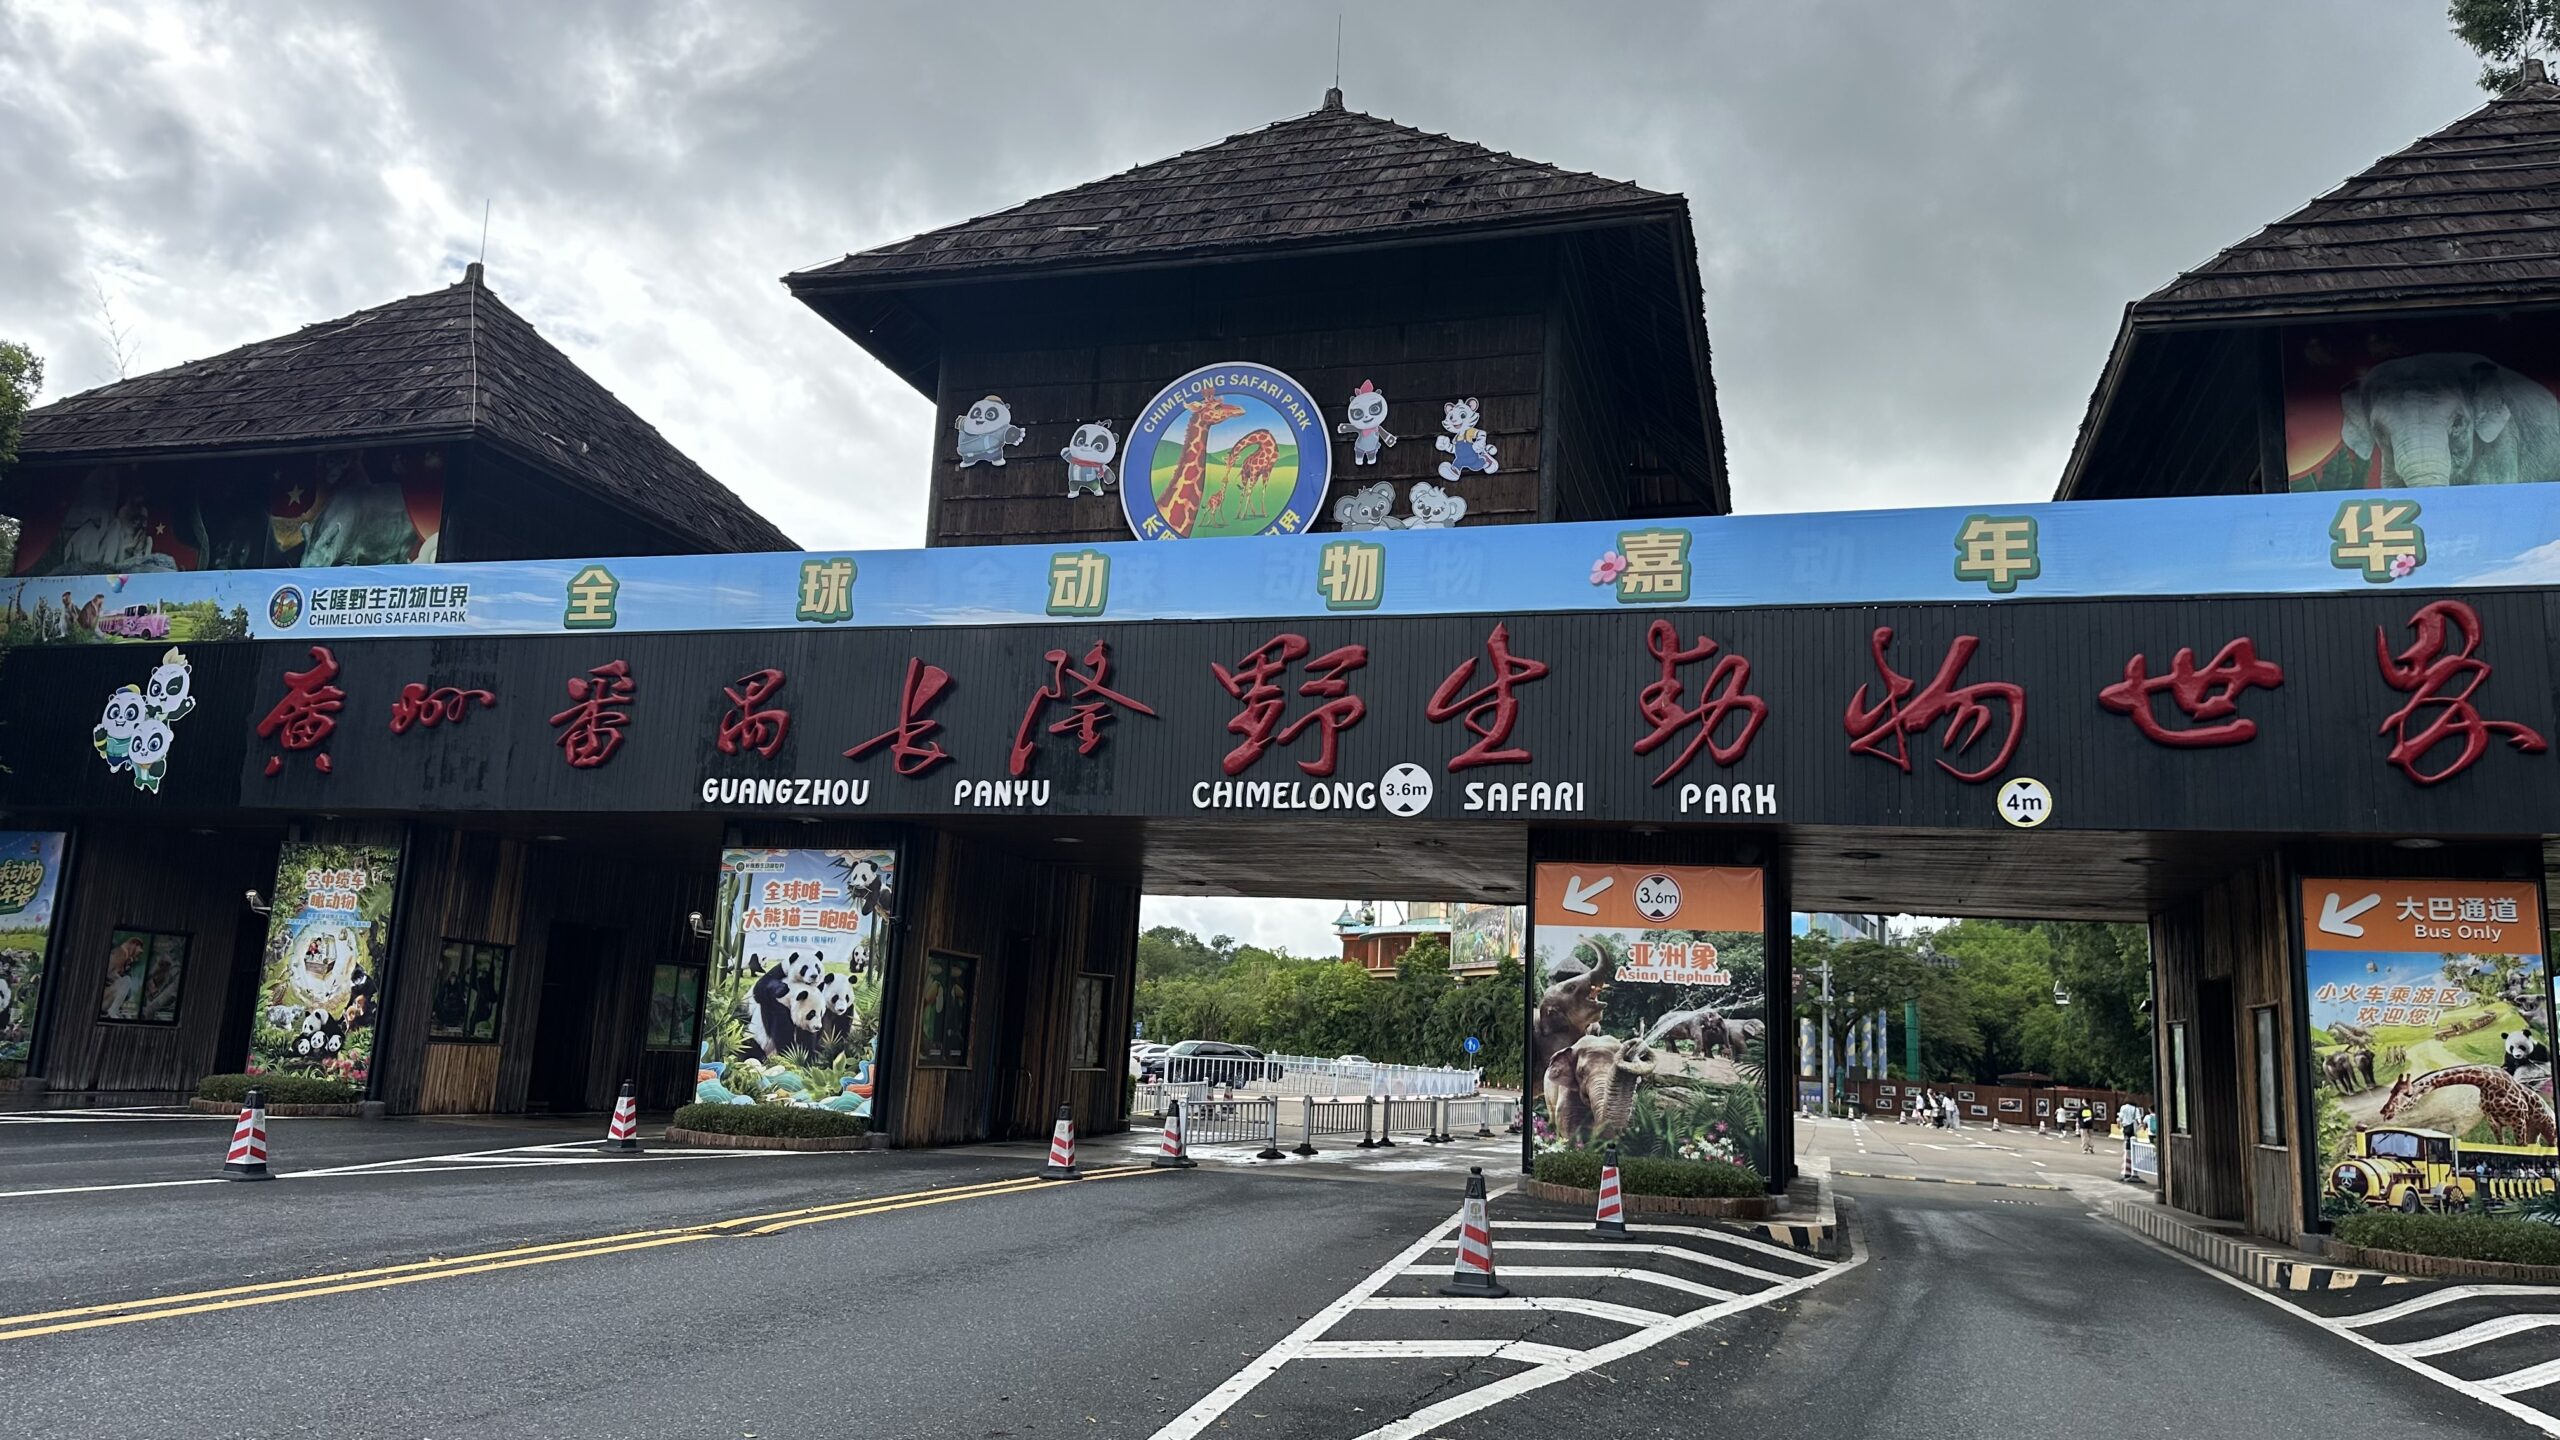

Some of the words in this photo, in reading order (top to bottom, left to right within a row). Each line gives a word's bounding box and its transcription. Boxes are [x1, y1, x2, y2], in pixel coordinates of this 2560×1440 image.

[1143, 374, 1226, 434] CHIMELONG
[1229, 373, 1284, 400] SAFARI
[1281, 392, 1313, 432] PARK
[310, 585, 469, 611] 长隆野生动物世界
[309, 612, 382, 626] CHIMELONG
[385, 611, 430, 624] SAFARI
[435, 610, 466, 623] PARK
[701, 777, 870, 807] GUANGZHOU
[953, 779, 1051, 808] PANYU
[1192, 780, 1376, 811] CHIMELONG
[1463, 781, 1585, 813] SAFARI
[1679, 783, 1778, 815] PARK
[1385, 782, 1428, 797] 3.6m
[2005, 794, 2043, 812] 4m
[305, 869, 366, 891] 空中缆车
[309, 890, 357, 911] 瞰动物
[764, 880, 839, 903] 全球唯一
[1639, 887, 1678, 905] 3.6m
[743, 907, 859, 932] 大熊猫三胞胎
[2396, 896, 2519, 923] 大巴通道
[2414, 924, 2452, 939] Bus
[2457, 925, 2502, 942] Only
[1630, 943, 1717, 970] 亚洲象
[1616, 966, 1659, 981] Asian
[1664, 970, 1731, 985] Elephant
